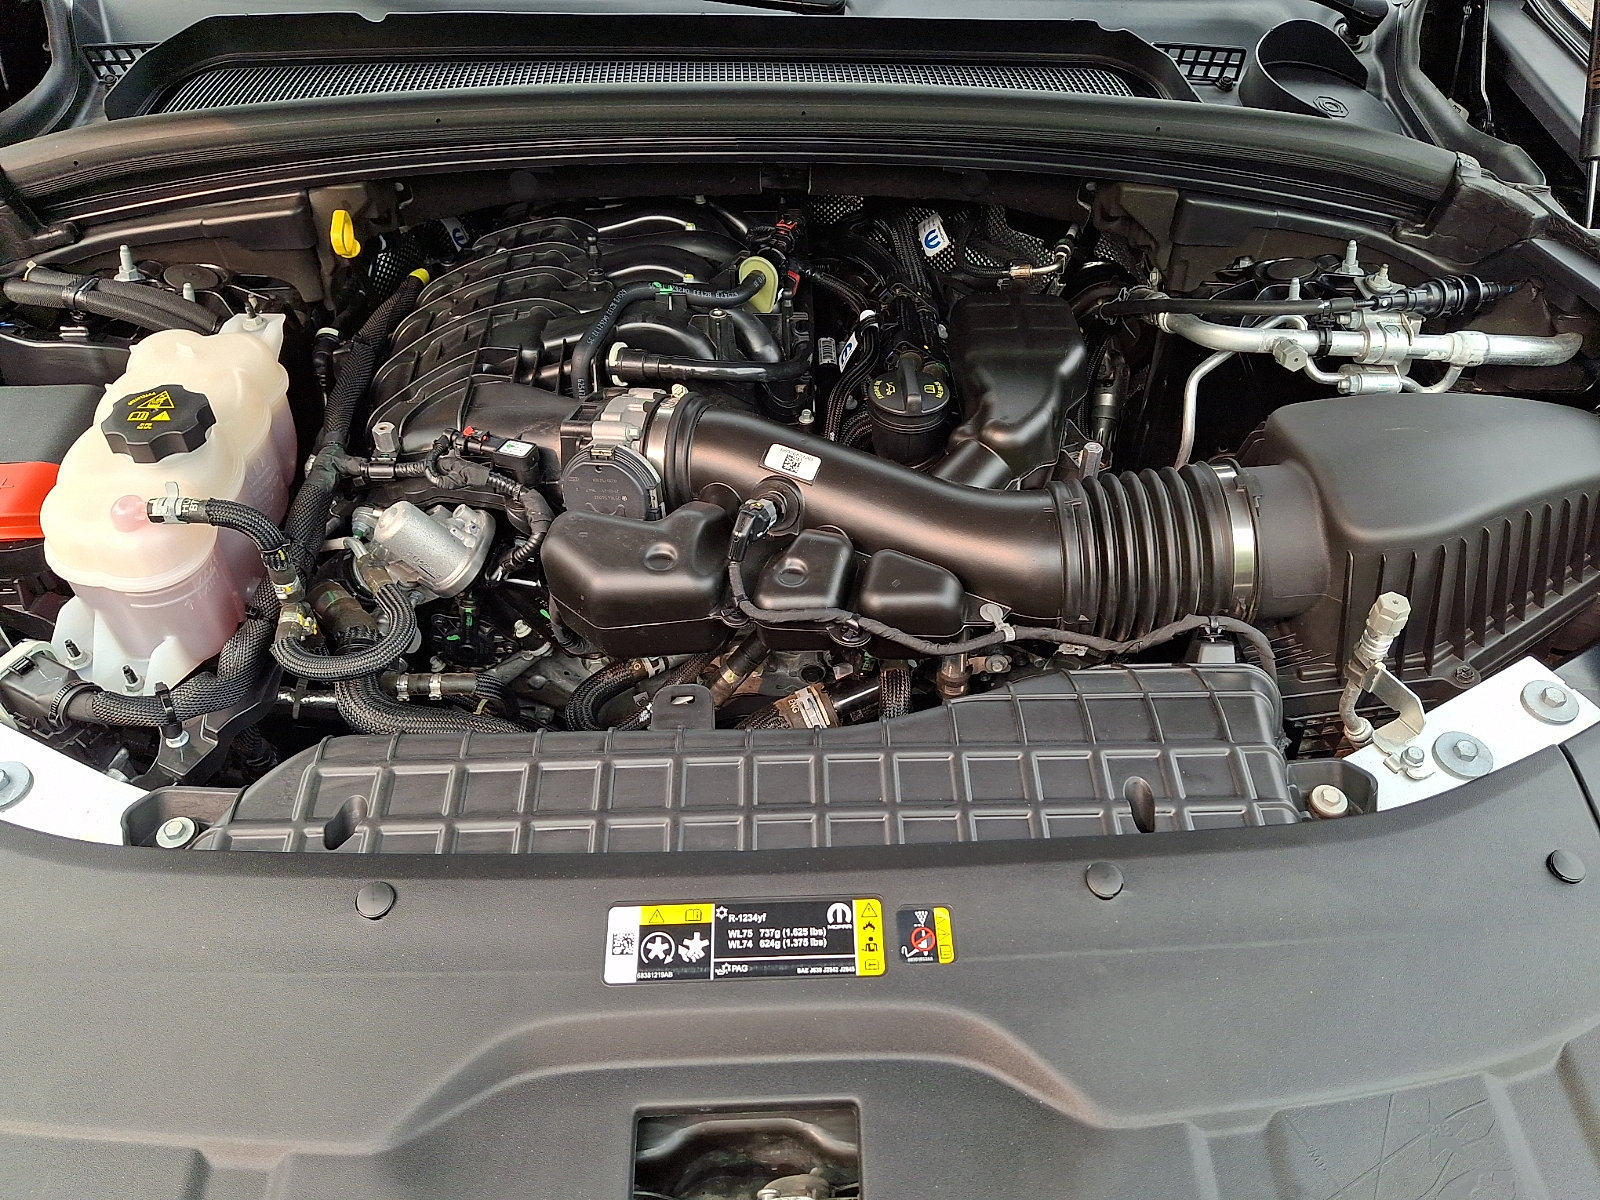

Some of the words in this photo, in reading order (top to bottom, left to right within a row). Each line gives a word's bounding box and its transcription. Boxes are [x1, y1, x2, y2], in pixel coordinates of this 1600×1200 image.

[728, 913, 766, 923] R-1234yf
[728, 929, 753, 939] WL75
[759, 928, 781, 939] 737g
[782, 927, 809, 938] (1.625
[810, 926, 827, 937] lbs)
[728, 940, 753, 949] WL74
[759, 939, 781, 950] 624g
[782, 938, 809, 949] (1.375
[810, 937, 828, 948] lbs)
[732, 964, 749, 973] PAG
